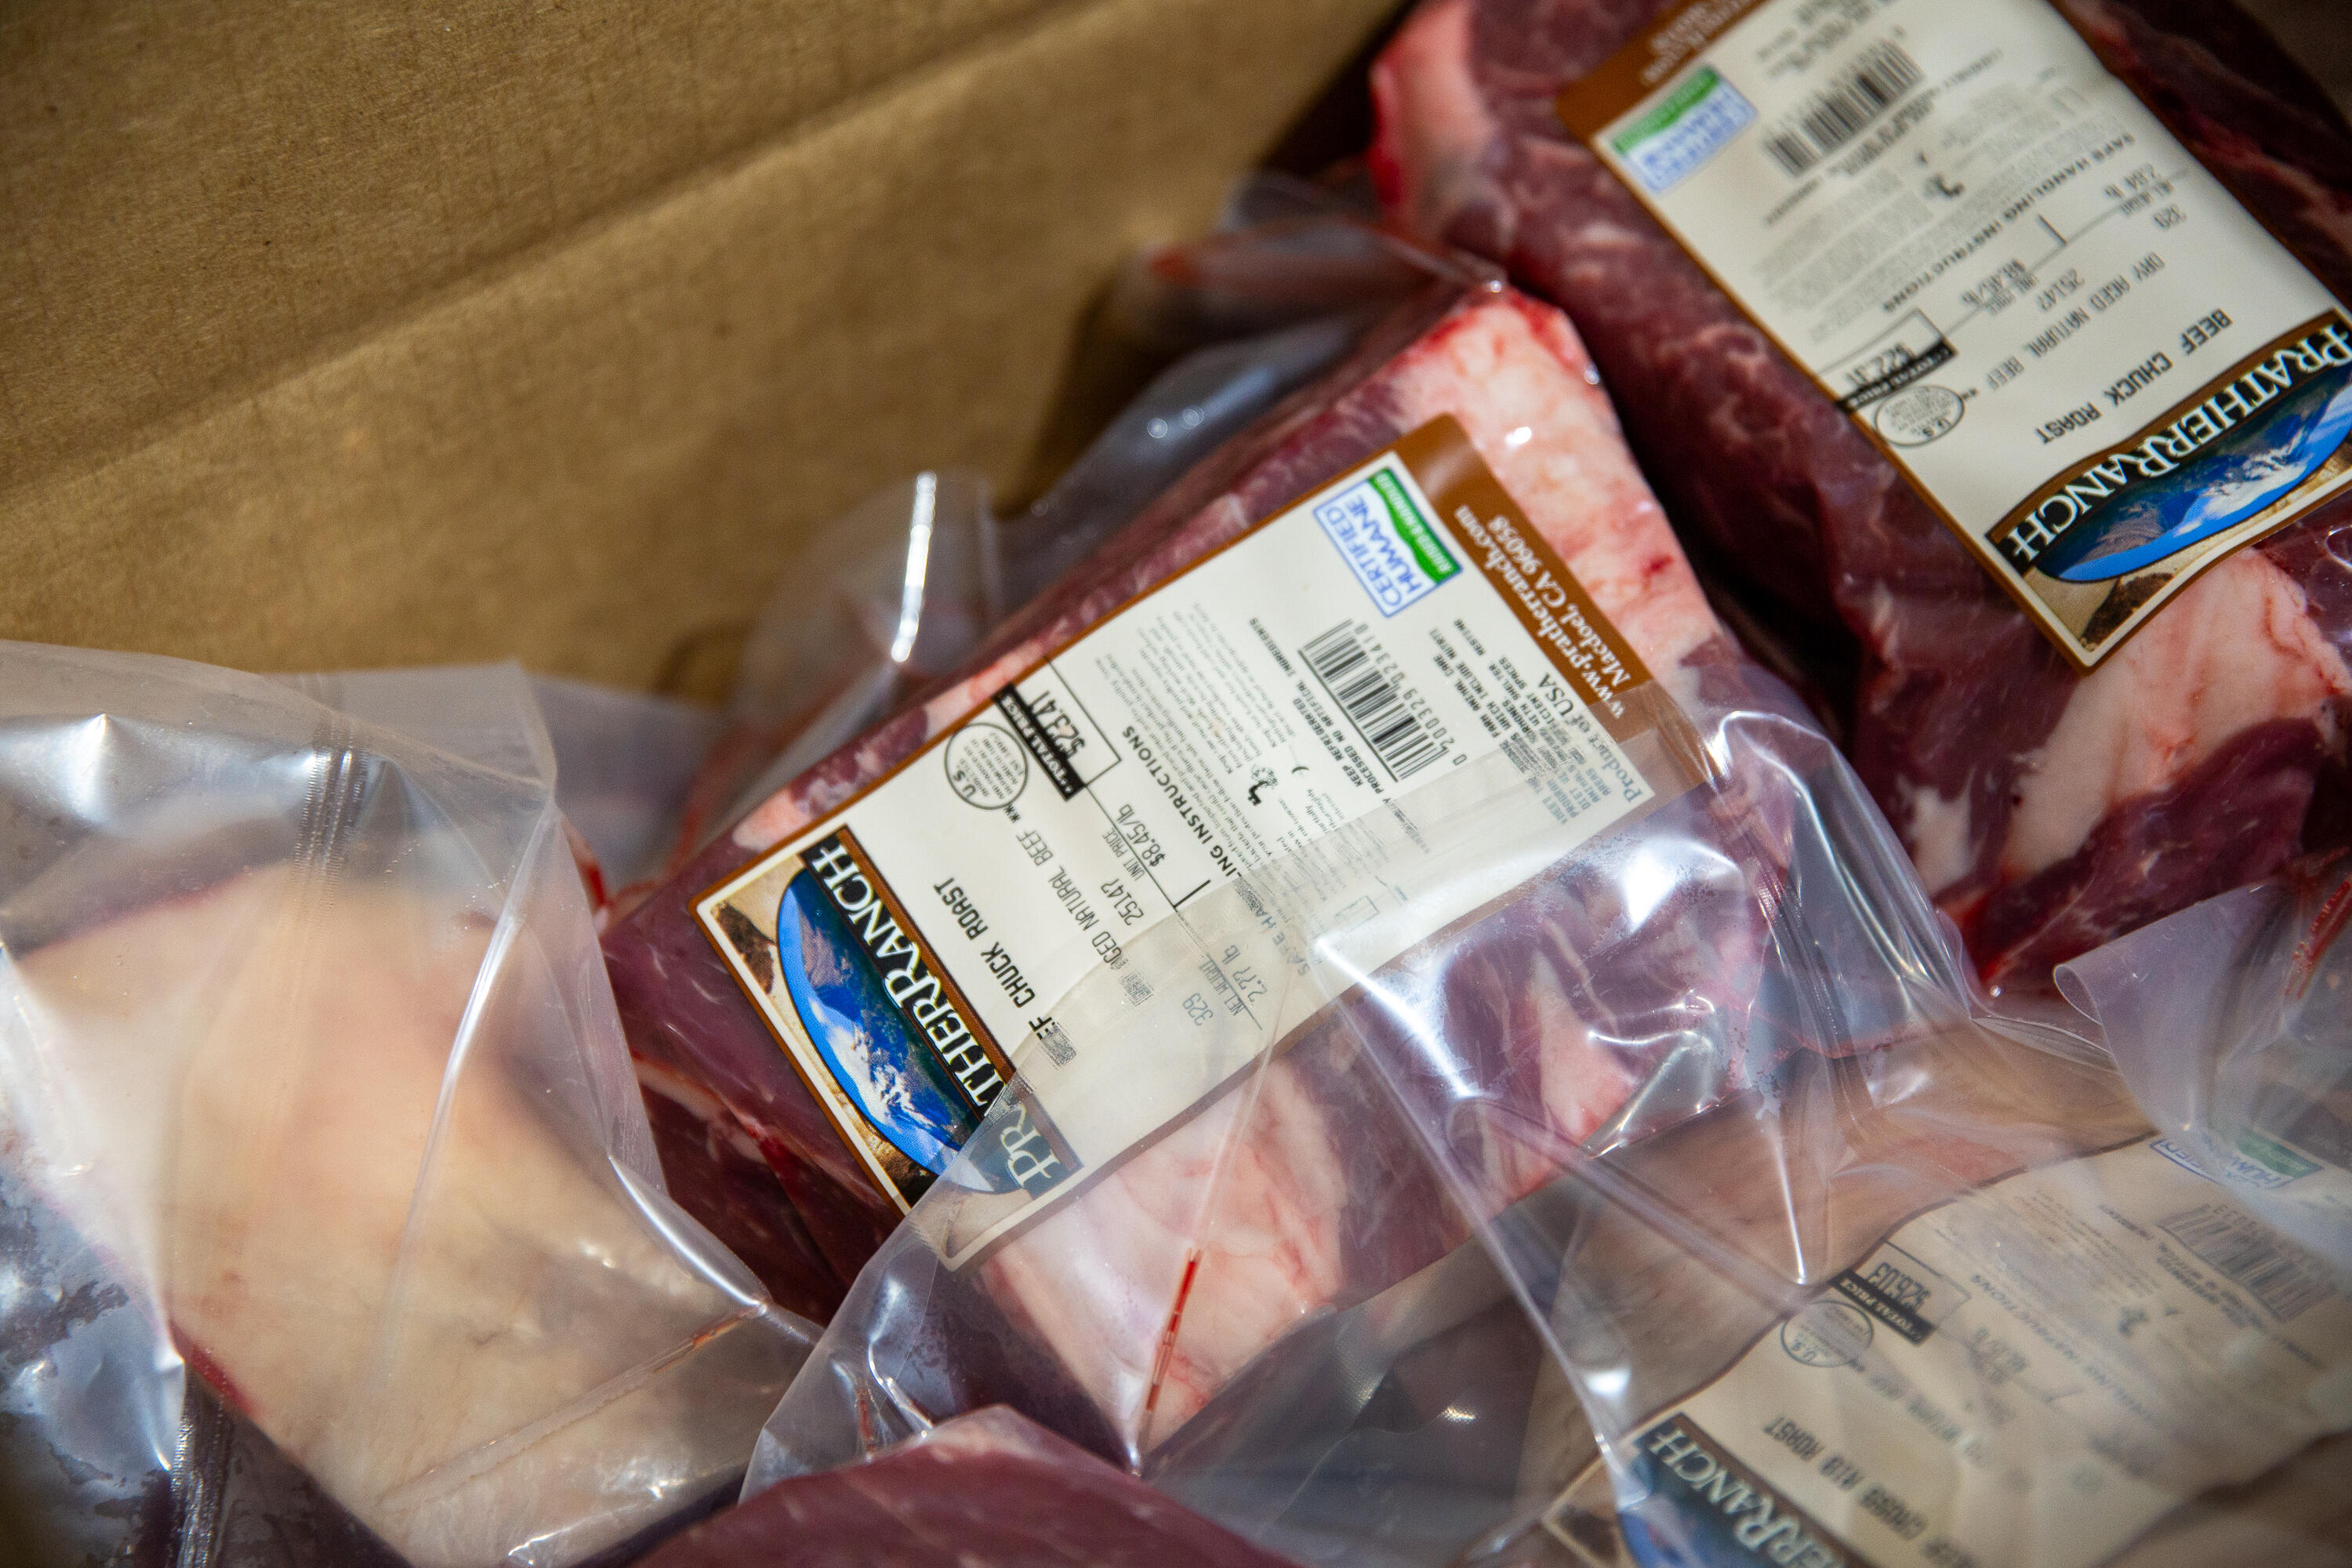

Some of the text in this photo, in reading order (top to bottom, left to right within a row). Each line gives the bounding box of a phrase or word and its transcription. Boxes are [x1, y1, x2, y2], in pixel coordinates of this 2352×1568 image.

[2089, 275, 2132, 312] AGED
[2024, 307, 2091, 359] NATURAL
[1984, 356, 2024, 390] BEEF
[2034, 307, 2233, 443] BEEF CHUCK ROAST
[2005, 324, 2349, 561] PRATHERRANCH
[1323, 503, 1404, 608] CERTIFIED
[1344, 494, 1422, 594] HUMANE
[1453, 503, 1624, 718] www.pratherranch.com
[1485, 513, 1631, 687] Macdoel, CA 96058
[1248, 617, 1296, 676] INGREDIENTS
[1453, 618, 1486, 656] RESTING
[1432, 653, 1454, 676] CARE
[1455, 661, 1489, 699] INCLUDE
[1000, 695, 1036, 737] PRICE
[1452, 678, 1481, 711] ANIMAL
[1486, 700, 1512, 729] WHICH
[1519, 702, 1541, 726] WITH
[1526, 691, 1570, 744] ICIENT
[1534, 671, 1576, 717] USA
[1025, 691, 1087, 758] $23.41
[1291, 696, 1344, 760] REFRIGERATED
[1331, 728, 1345, 742] NO
[1479, 713, 1501, 737] FARM
[949, 764, 977, 797] U.S.
[1120, 725, 1213, 844] INSTRUCTIONS
[1341, 763, 1363, 786] KEEP
[1343, 744, 1384, 793] PROCESSED
[1582, 731, 1643, 803] Product
[1015, 826, 1054, 866] BEEF
[1102, 827, 1145, 880] UNIT PRICE
[1112, 804, 1167, 867] $8.45/lb
[1044, 866, 1100, 930] NATURAL
[1100, 877, 1144, 925] 25147
[1208, 844, 1276, 931] HAING
[932, 874, 1078, 1066] EF CHUCK ROAST
[1198, 959, 1246, 1015] NET WEIGHT
[1217, 944, 1268, 1001] 2.77 lb
[1181, 992, 1215, 1026] 329
[1760, 1417, 1826, 1457] ROAST
[1648, 1431, 1835, 1567] ERRANCH
